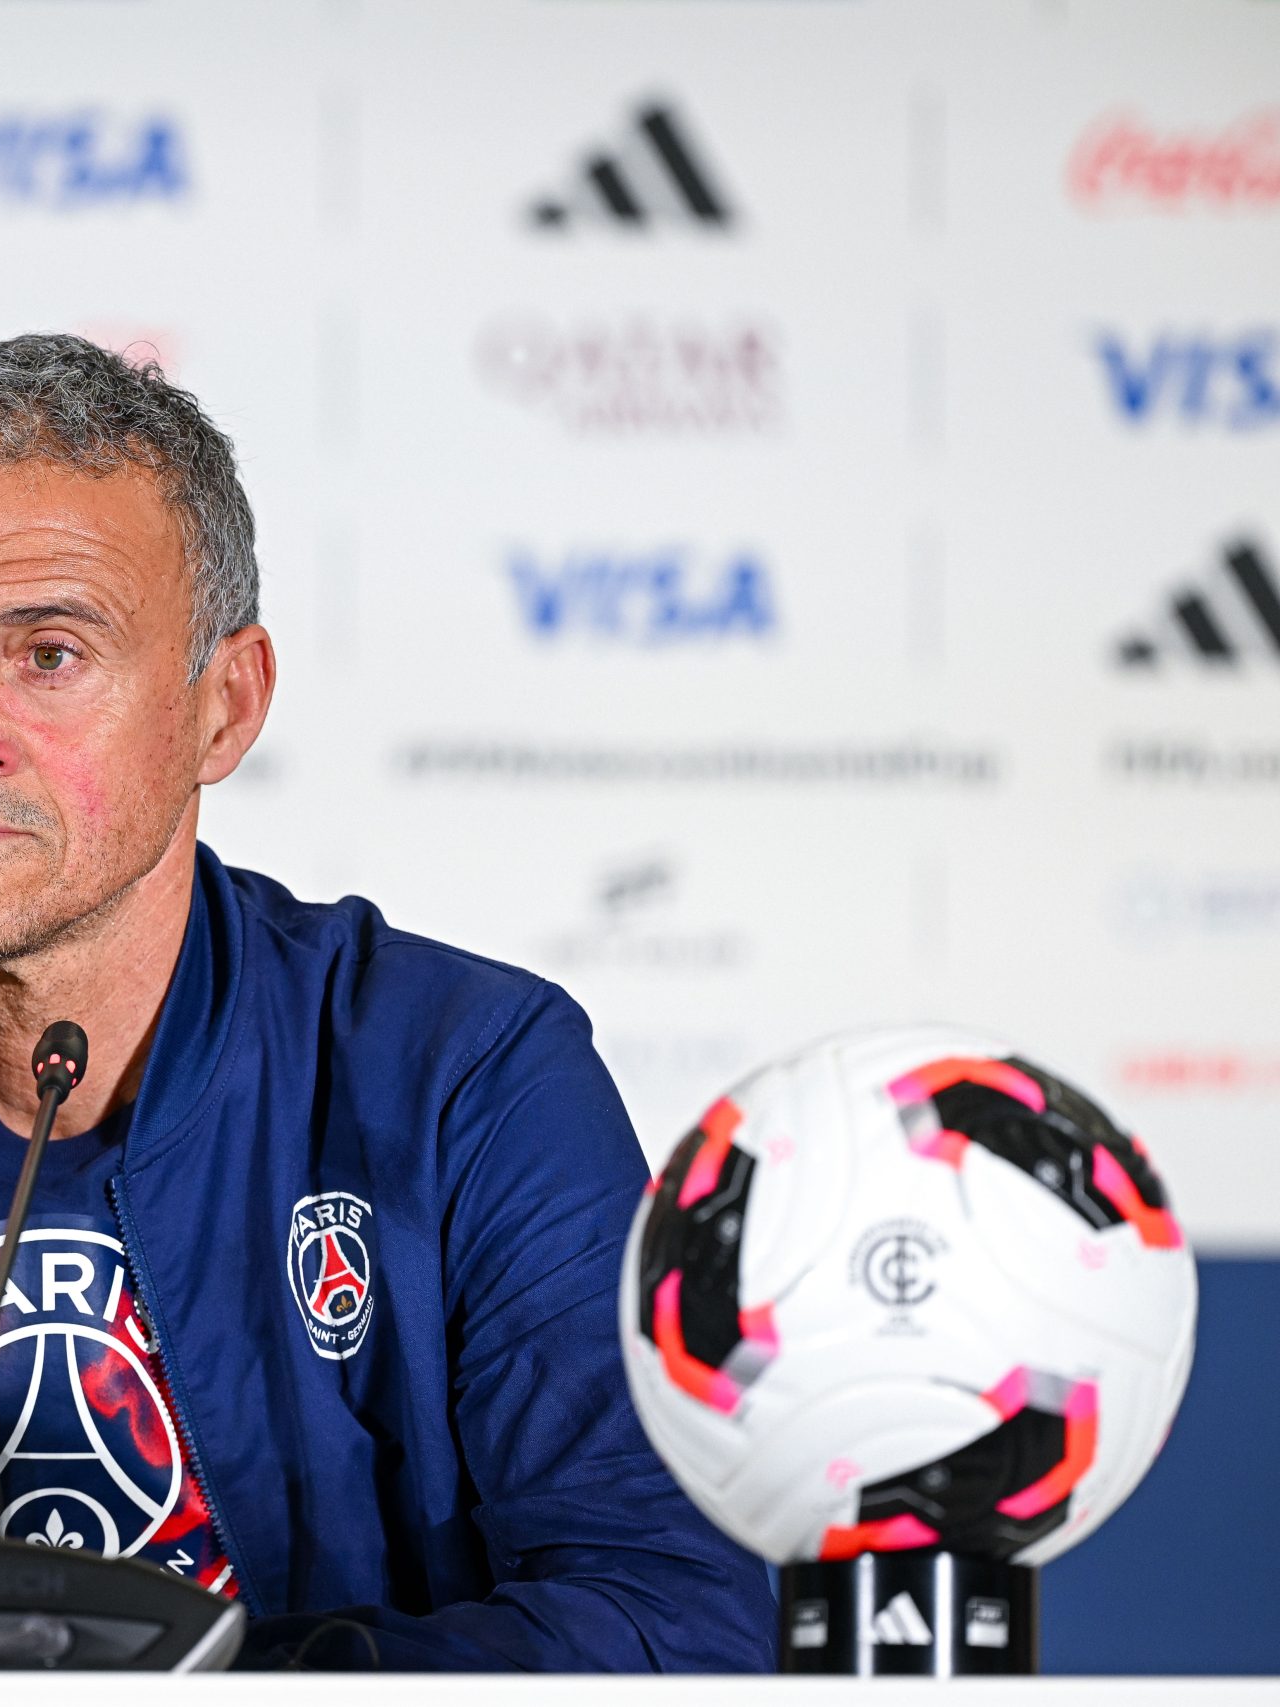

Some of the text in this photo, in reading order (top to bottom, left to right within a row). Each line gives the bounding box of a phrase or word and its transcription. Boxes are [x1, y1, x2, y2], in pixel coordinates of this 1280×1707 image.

[1094, 328, 1280, 426] VIS
[506, 548, 778, 642] VISA
[293, 1201, 362, 1249] PARIS
